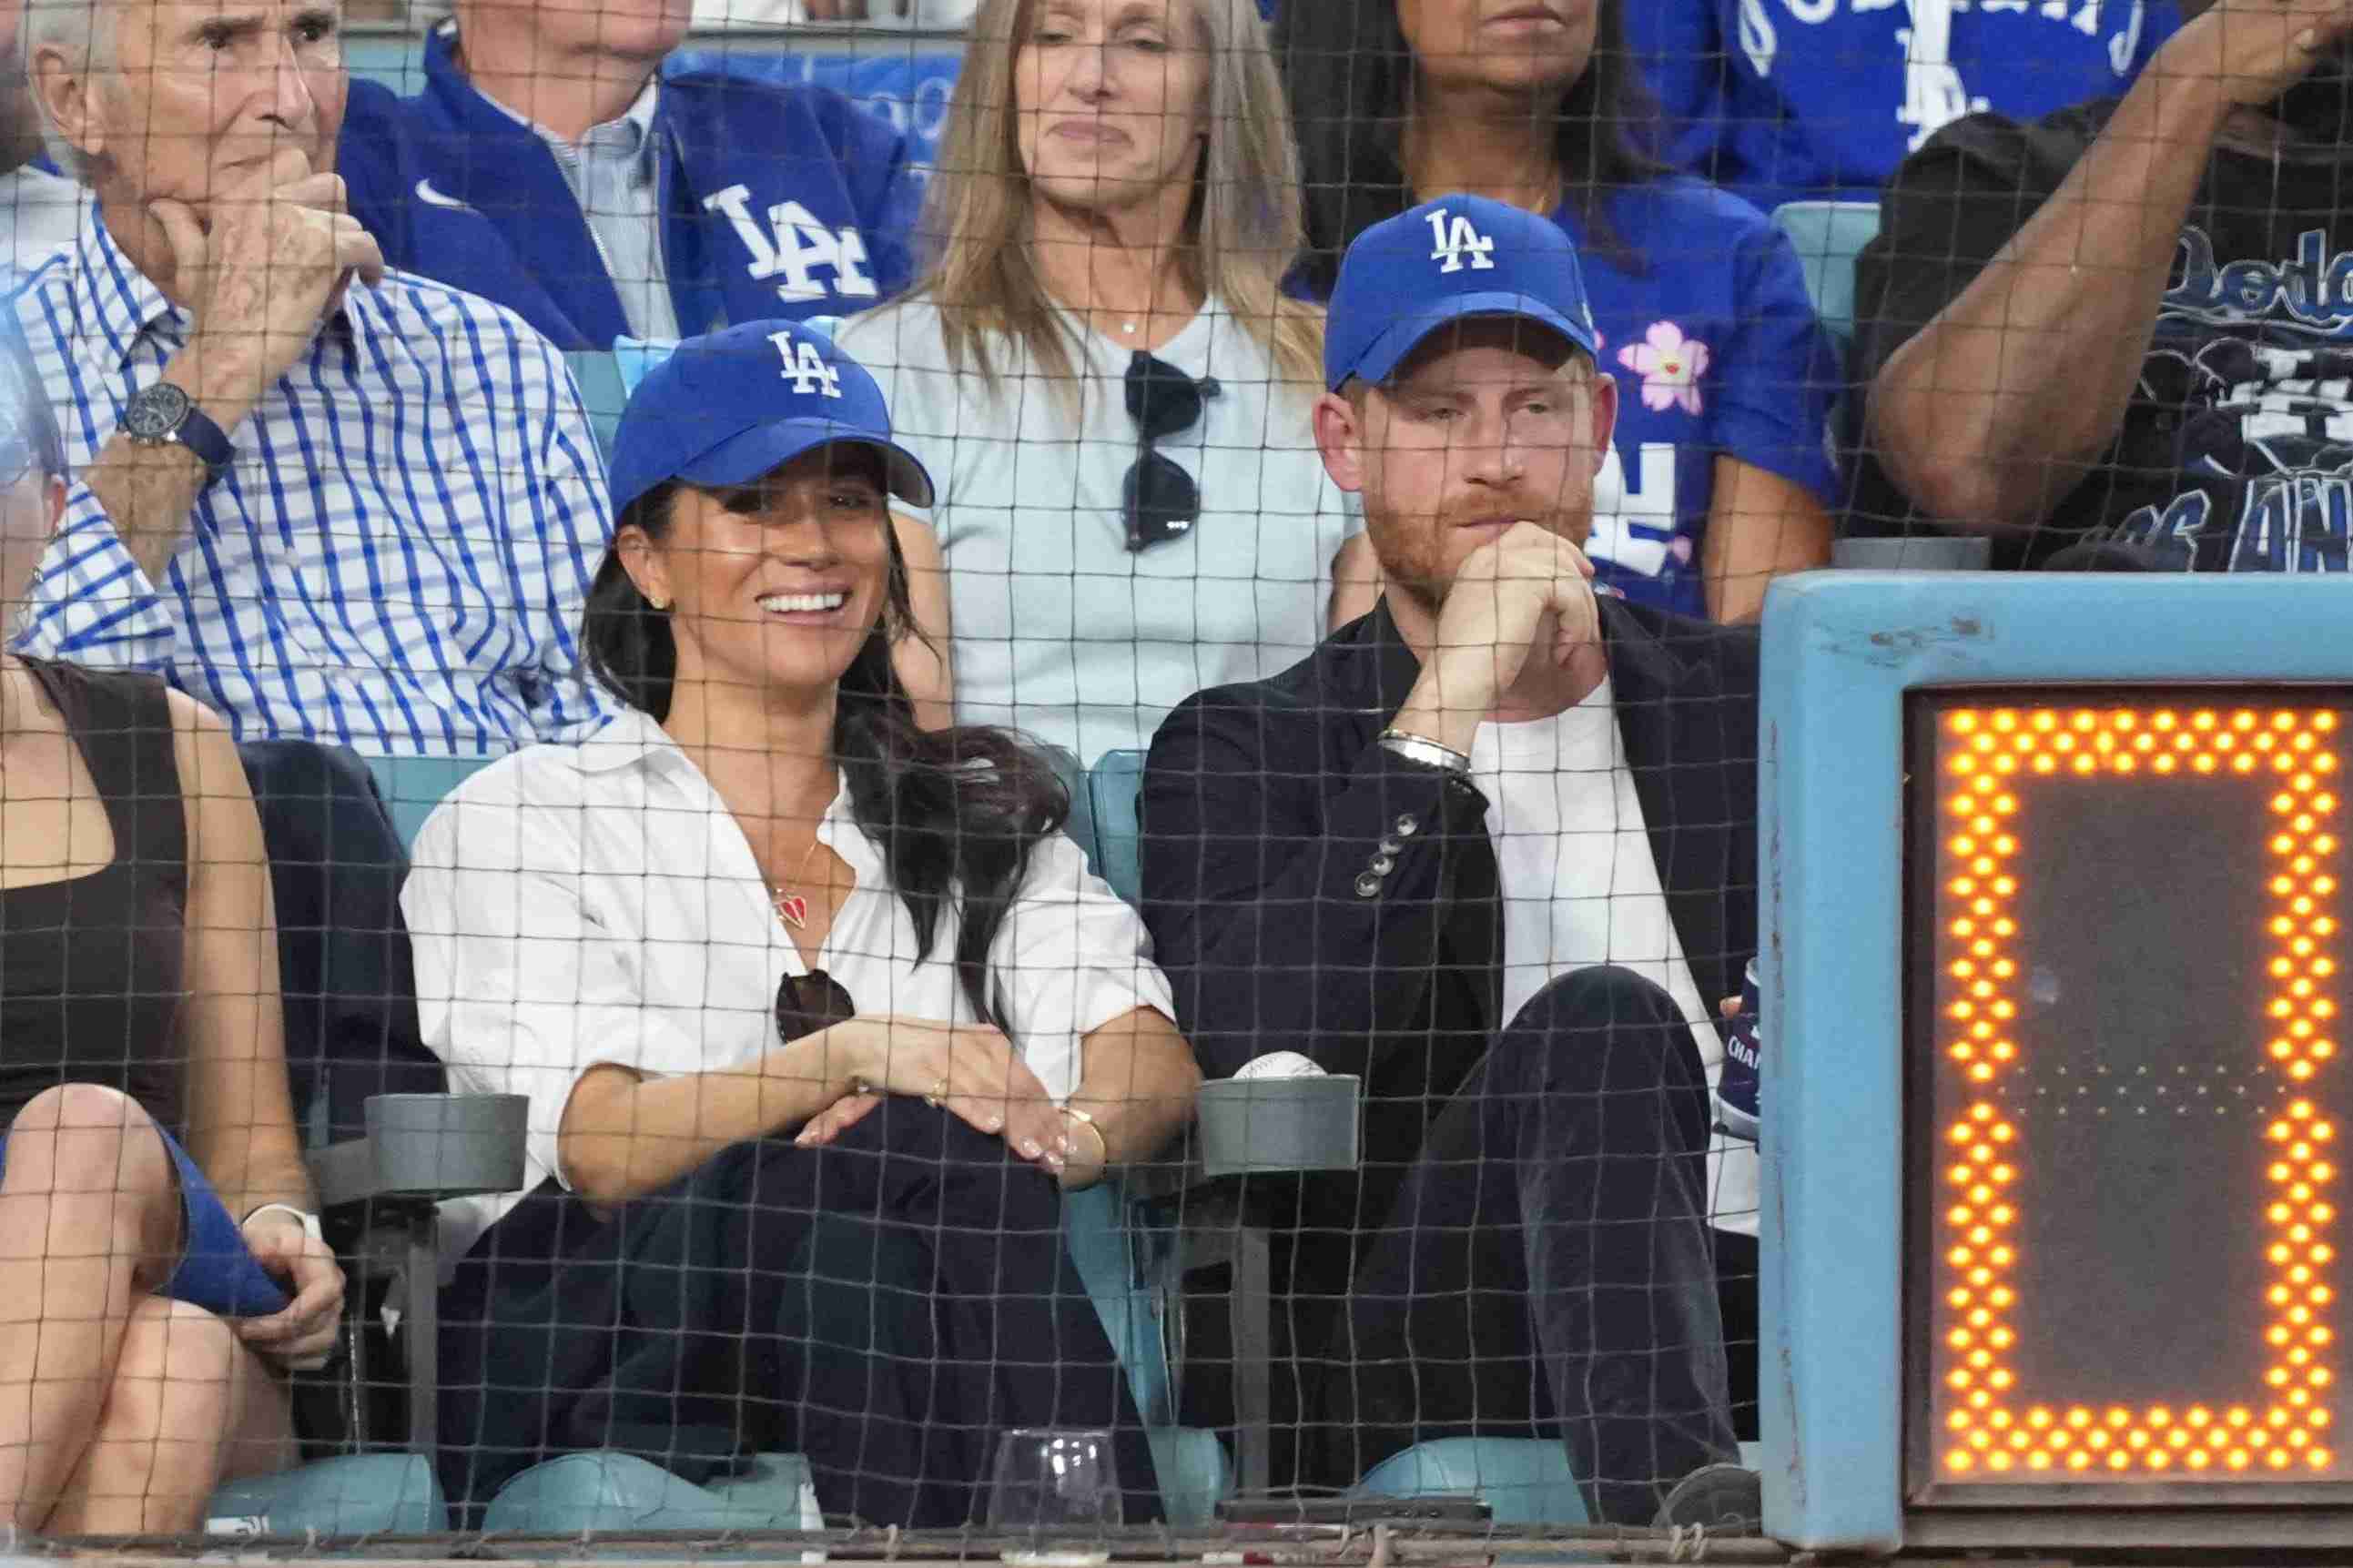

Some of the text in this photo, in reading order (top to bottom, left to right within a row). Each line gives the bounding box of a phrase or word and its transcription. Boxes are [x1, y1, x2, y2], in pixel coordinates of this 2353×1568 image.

[703, 184, 878, 303] LA
[1425, 208, 1496, 273] LA
[766, 330, 842, 399] LA
